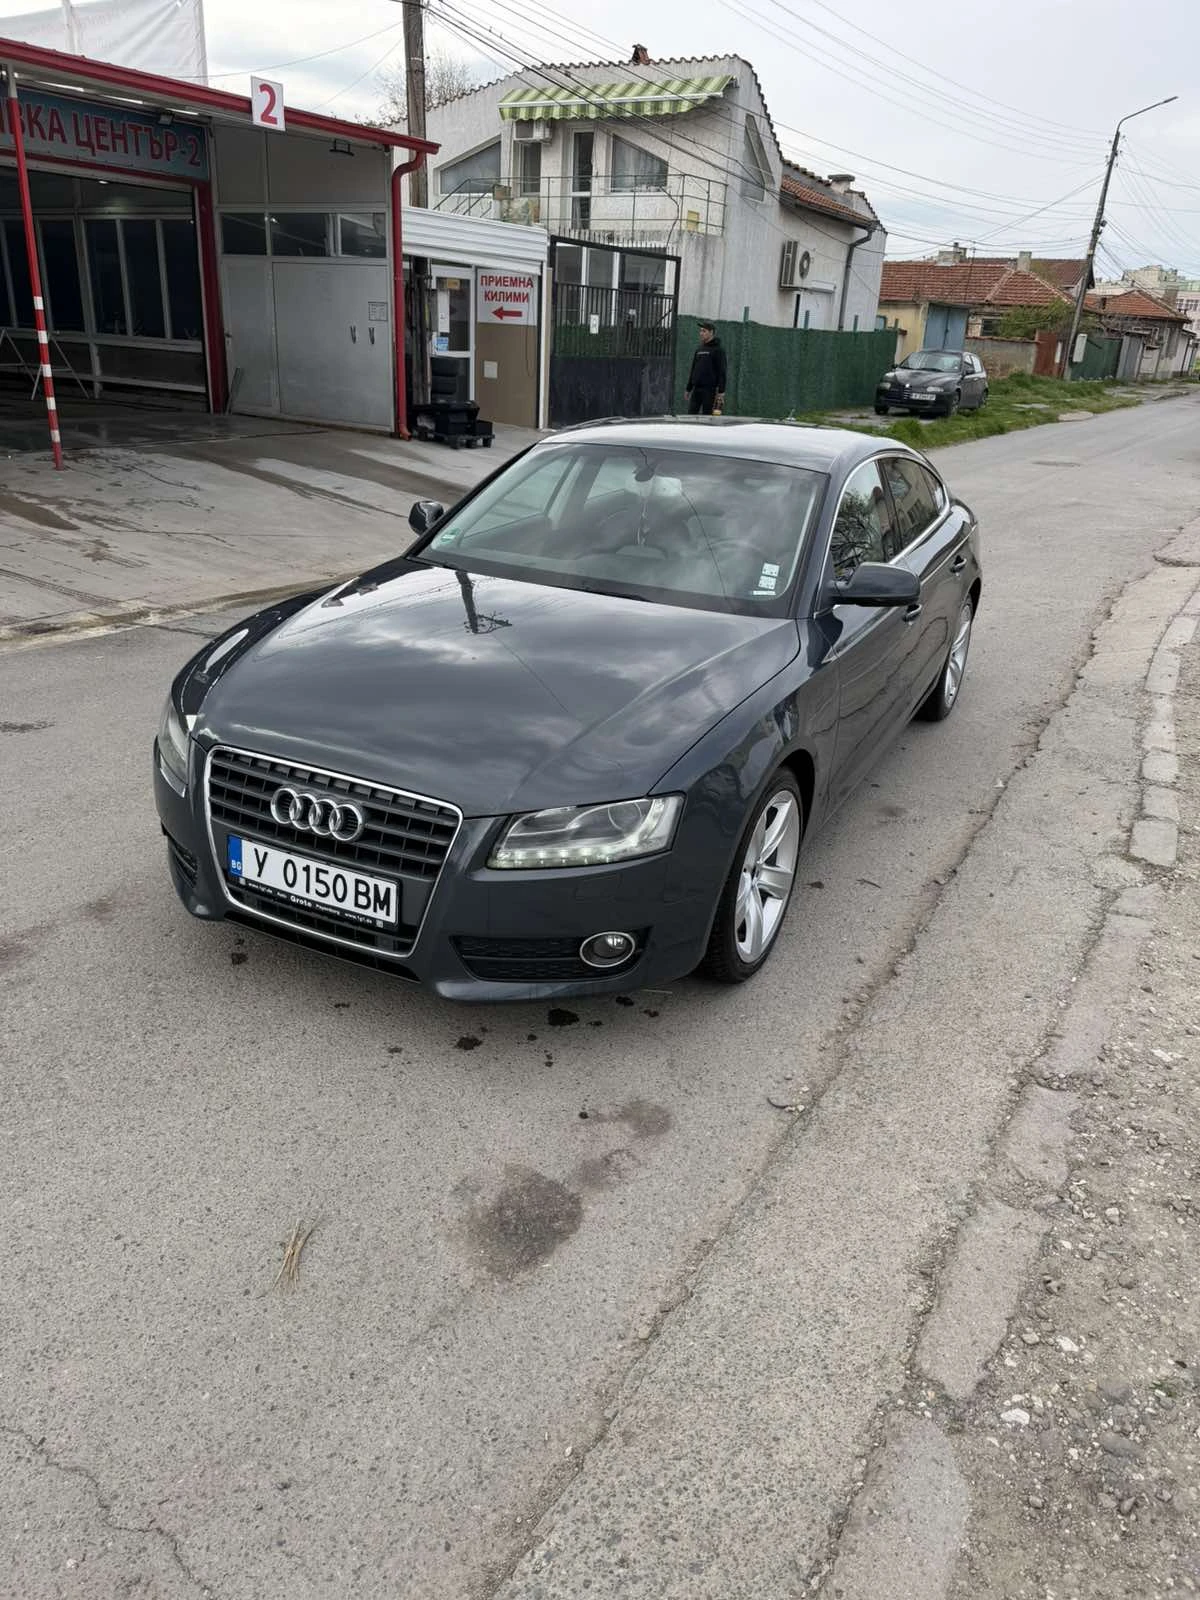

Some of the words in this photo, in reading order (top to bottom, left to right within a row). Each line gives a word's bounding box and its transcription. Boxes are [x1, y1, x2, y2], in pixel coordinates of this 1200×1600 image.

[258, 83, 278, 125] 2
[480, 275, 534, 288] ПРИЕМНА
[484, 291, 529, 303] КИЛИМИ
[231, 859, 242, 871] BG
